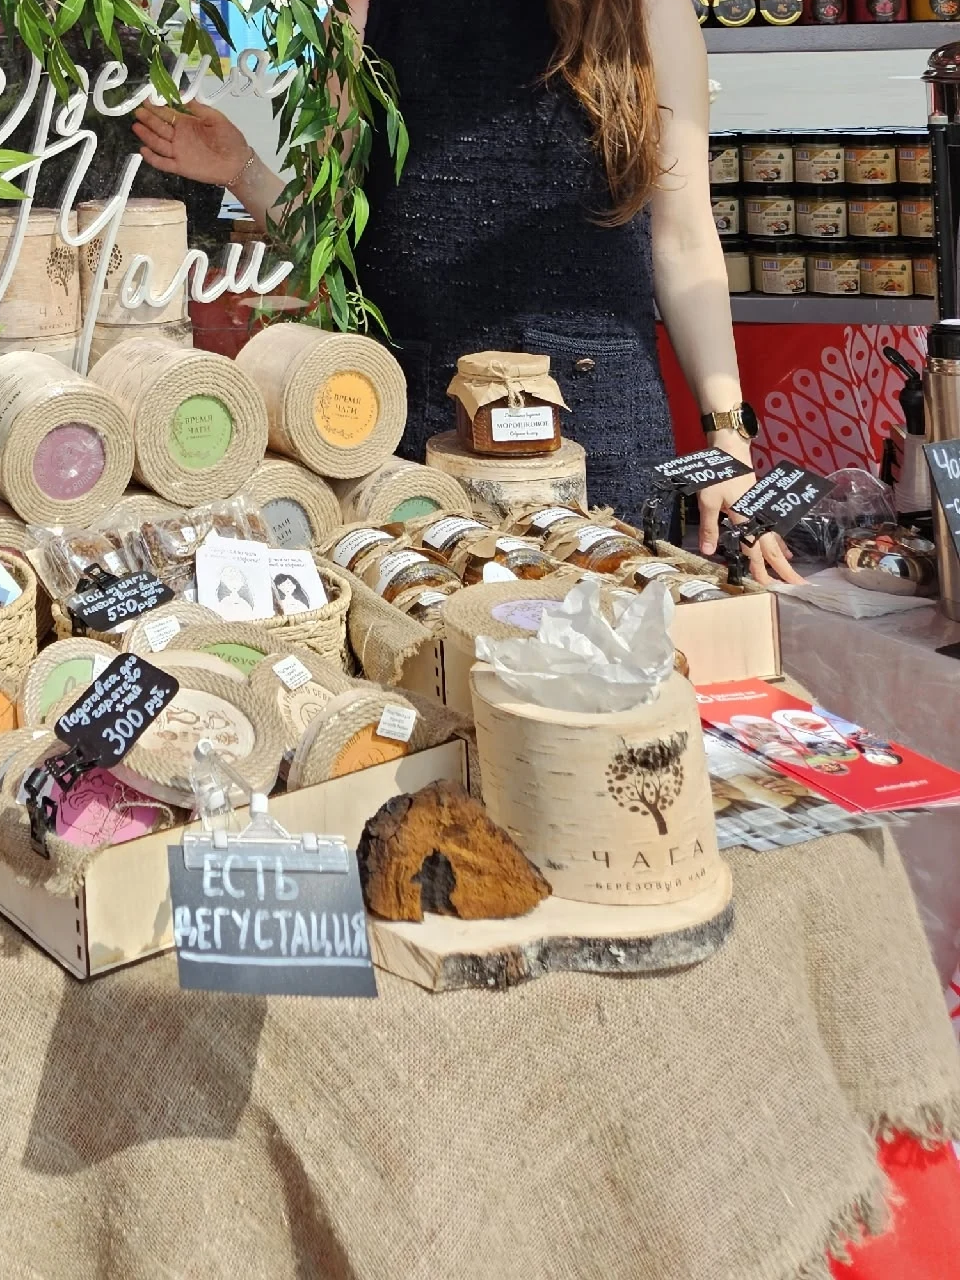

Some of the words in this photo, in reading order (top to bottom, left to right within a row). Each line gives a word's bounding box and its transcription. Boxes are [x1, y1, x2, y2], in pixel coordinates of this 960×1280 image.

[334, 393, 361, 405] ВРЕМЯ
[335, 404, 357, 415] ЧАГИ
[933, 448, 960, 479] Ча
[770, 492, 802, 518] 350
[107, 599, 138, 622] 550
[59, 673, 120, 733] Подставка
[101, 709, 144, 756] 300
[592, 838, 704, 869] ЧАГА
[202, 853, 300, 901] ЕСТЬ
[174, 904, 368, 958] ДЕГУСТАЦИЯ
